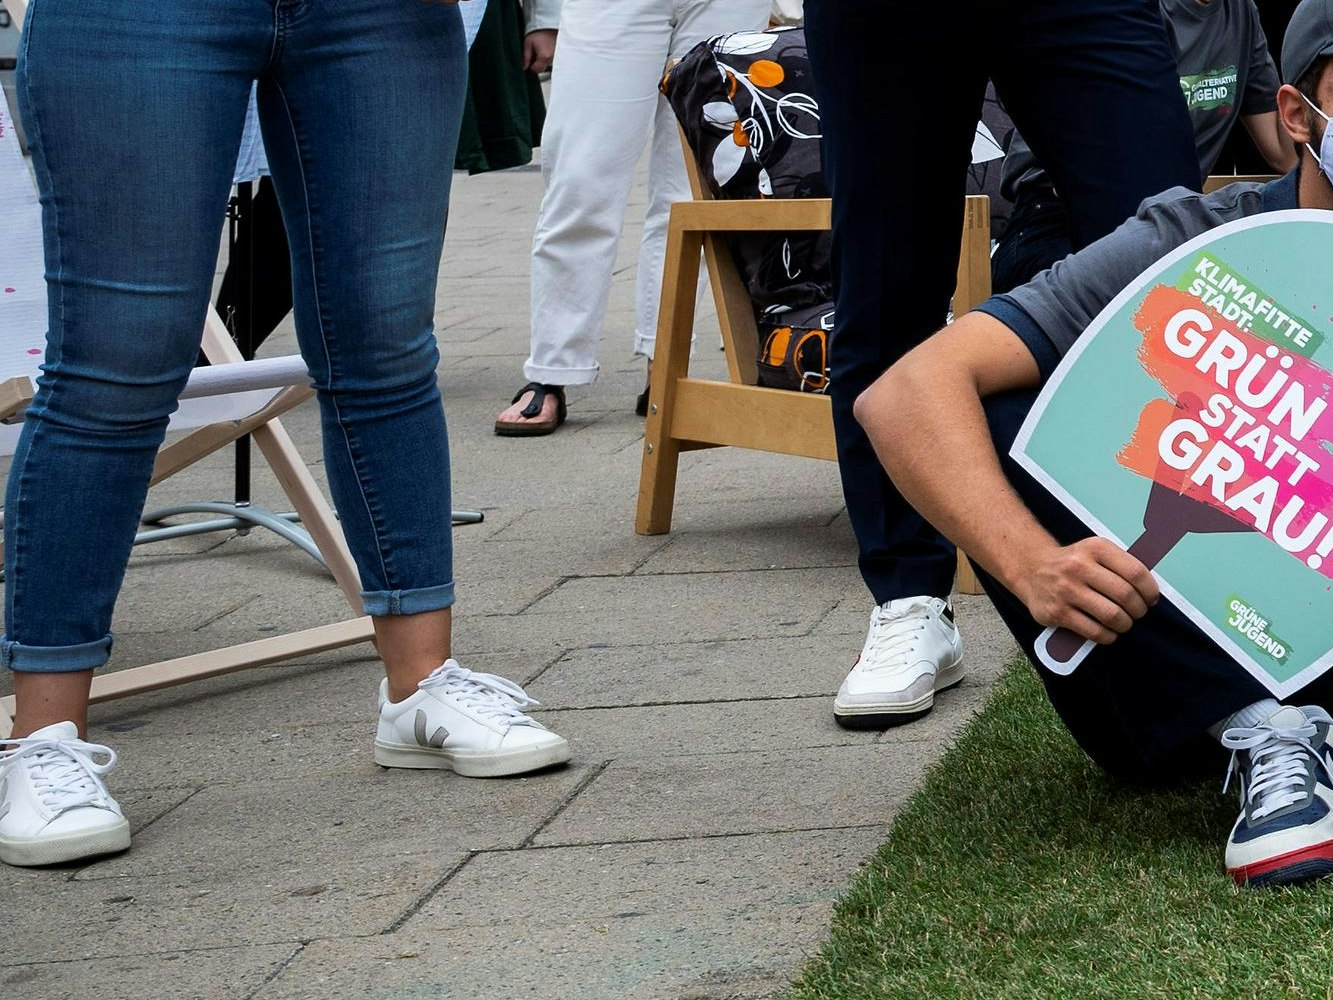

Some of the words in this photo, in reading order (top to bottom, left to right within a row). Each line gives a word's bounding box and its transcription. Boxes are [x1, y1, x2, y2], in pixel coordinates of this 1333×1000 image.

[1188, 279, 1253, 334] STADT:
[1194, 257, 1313, 349] KLIMAFITTE
[1163, 308, 1328, 443] GRÜN
[1199, 393, 1319, 487] STATT
[1228, 613, 1286, 659] JUGEND
[1230, 600, 1268, 631] GRÜNE
